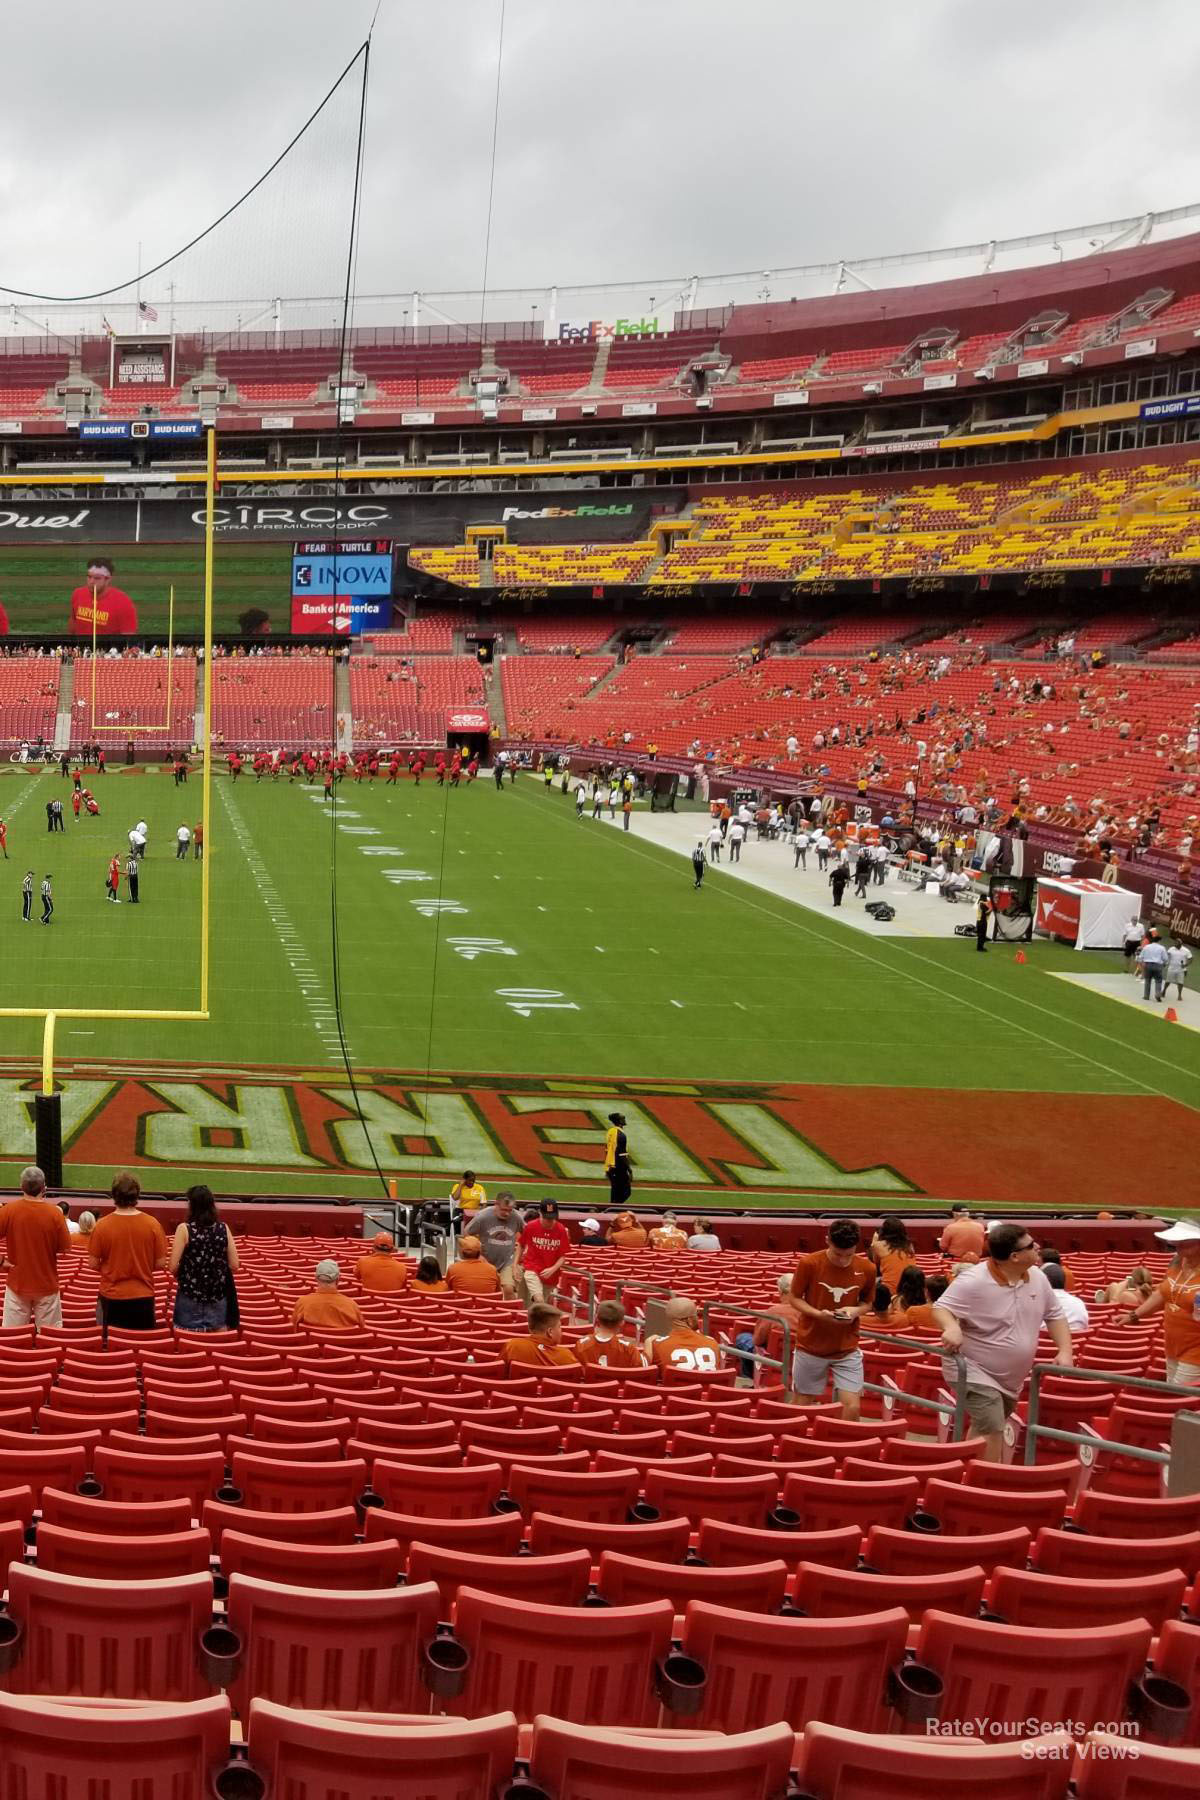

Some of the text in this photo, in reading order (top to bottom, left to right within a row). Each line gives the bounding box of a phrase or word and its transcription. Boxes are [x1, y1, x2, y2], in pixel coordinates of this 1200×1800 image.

[559, 317, 659, 339] FedExField
[1144, 405, 1161, 417] BUD
[1161, 401, 1185, 414] LIGHT
[83, 426, 126, 435] BUD LIGHT
[154, 424, 197, 434] BUD LIGHT
[502, 504, 633, 521] FedExField
[326, 520, 378, 530] VODKA
[318, 566, 388, 584] INOVA
[76, 607, 109, 621] MARYAND
[302, 603, 328, 614] Bank
[340, 602, 380, 614] America
[1153, 882, 1174, 909] 198
[1170, 907, 1190, 936] Hail
[531, 1236, 561, 1247] MARYLAND
[670, 1348, 718, 1372] 28
